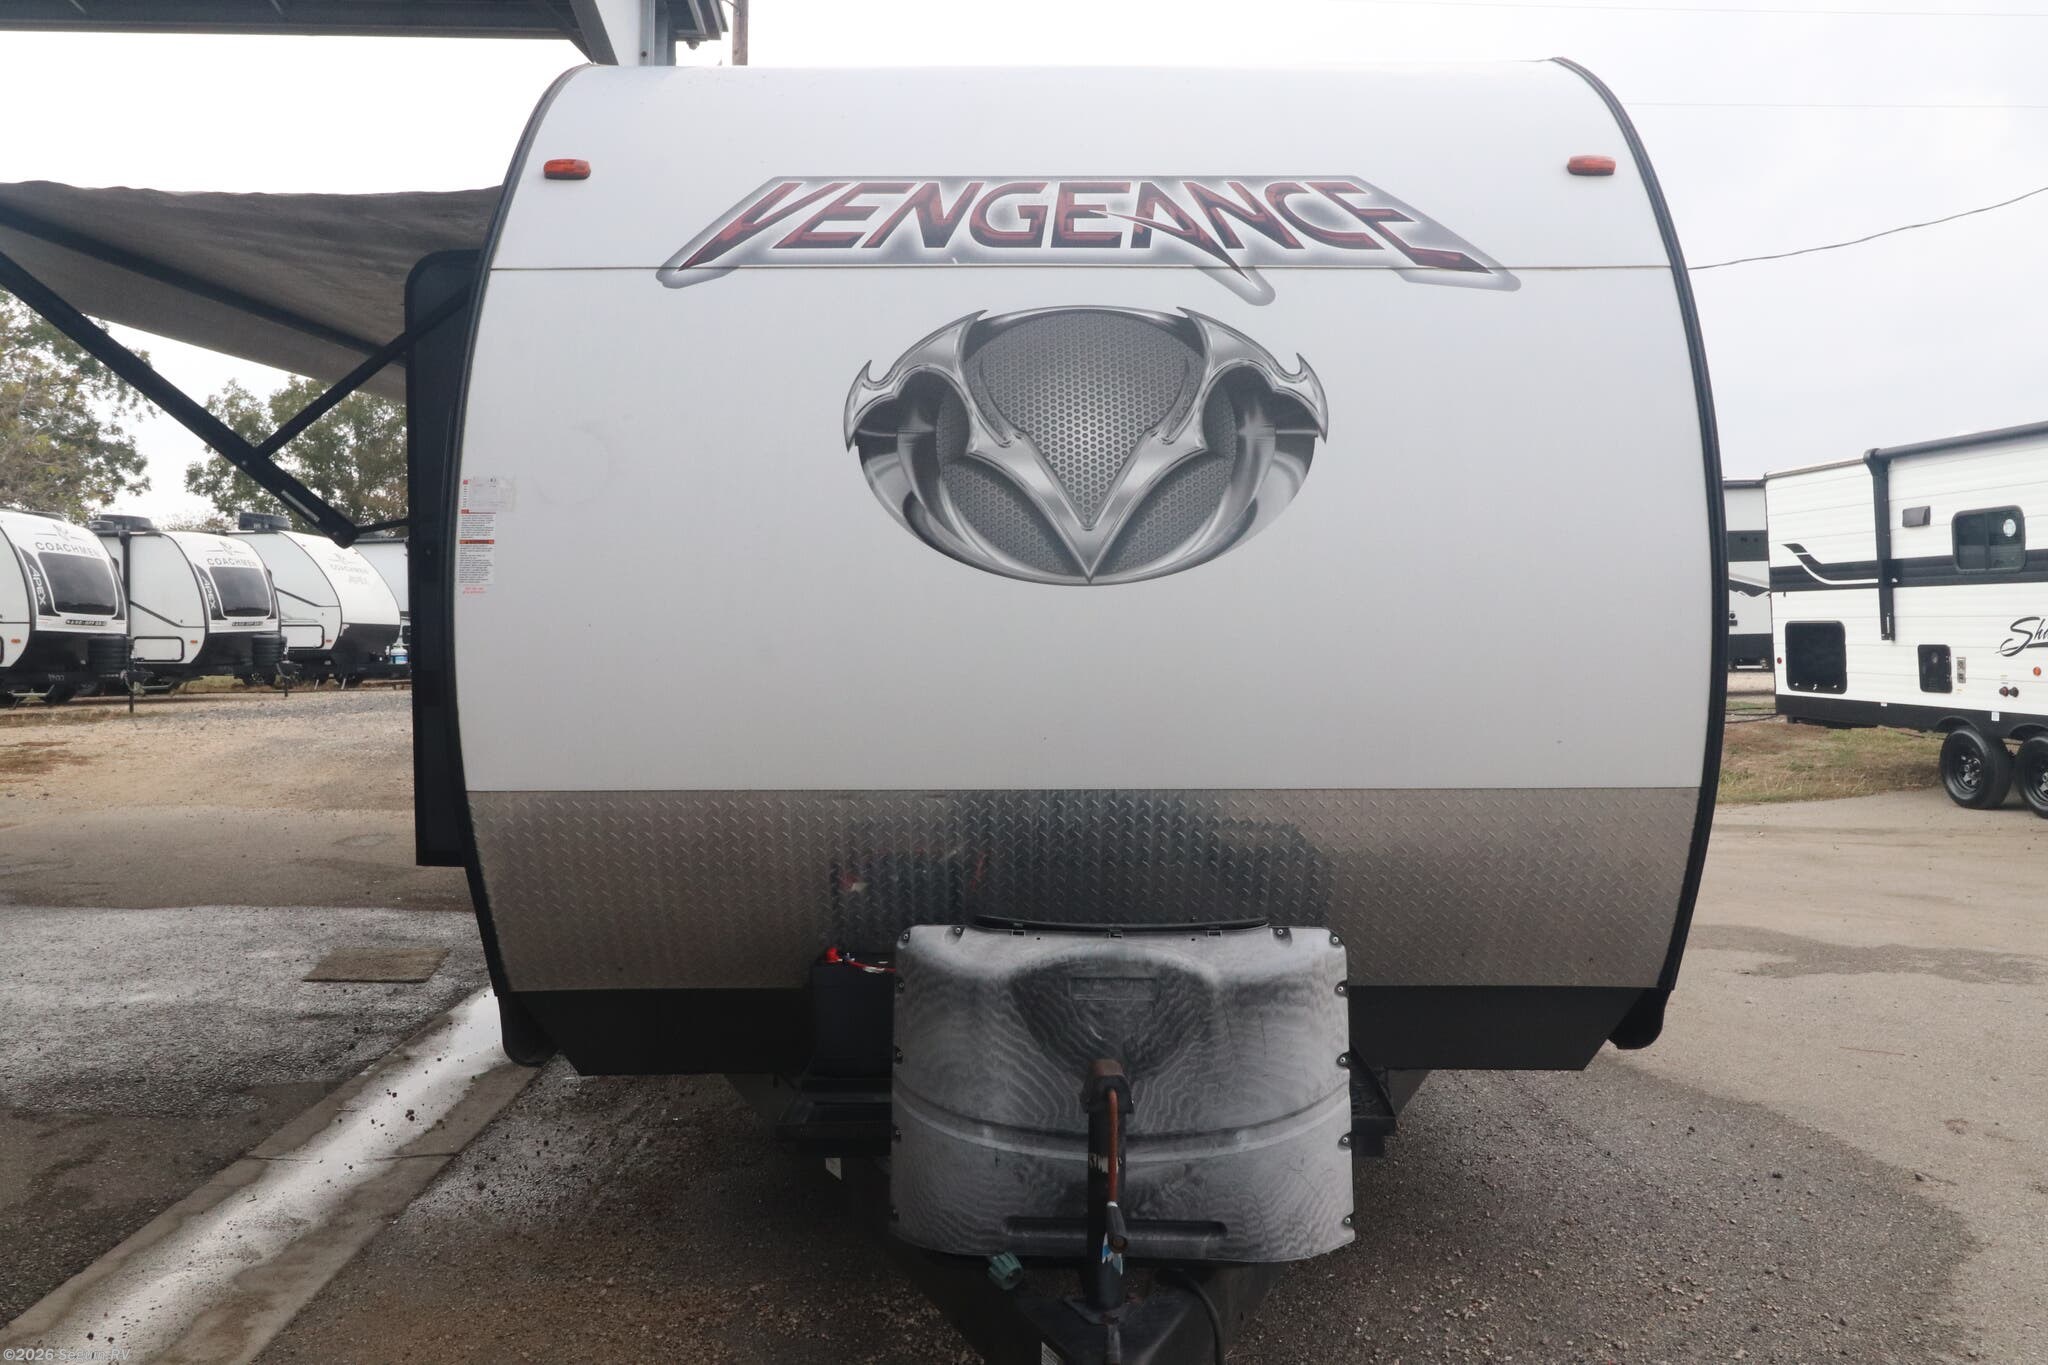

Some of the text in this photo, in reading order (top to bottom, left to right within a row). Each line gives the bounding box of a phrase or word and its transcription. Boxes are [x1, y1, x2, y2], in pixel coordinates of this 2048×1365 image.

[676, 180, 1496, 284] VENGEANCE
[35, 541, 101, 558] COACHMEN
[206, 557, 258, 567] COACHMEN
[28, 563, 47, 606] APEX
[201, 575, 217, 609] APEX
